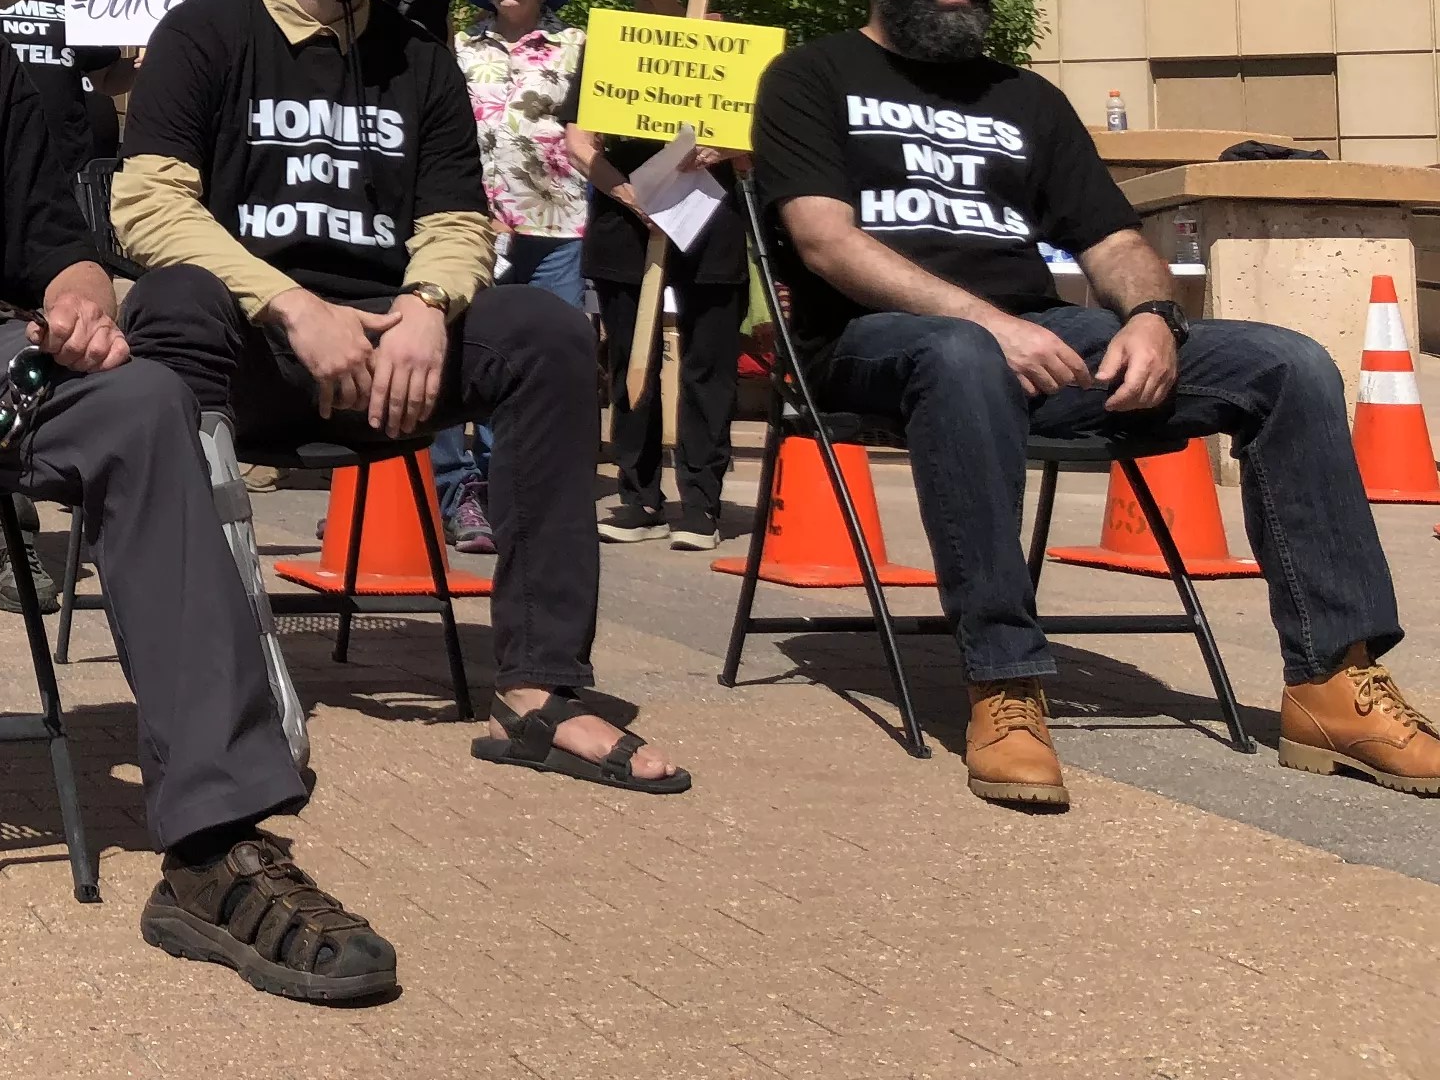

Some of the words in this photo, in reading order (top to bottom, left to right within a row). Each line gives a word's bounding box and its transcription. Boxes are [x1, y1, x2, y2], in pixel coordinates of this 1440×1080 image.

[2, 20, 51, 36] NOT
[619, 25, 698, 50] HOMES
[703, 34, 750, 55] NOT
[636, 56, 726, 81] HOTELS
[592, 80, 639, 105] Stop
[643, 86, 703, 109] Short
[846, 95, 1024, 151] HOUSES
[1110, 114, 1119, 125] G
[286, 153, 359, 189] NOT
[901, 143, 986, 185] NOT
[237, 202, 397, 249] HOTELS
[860, 188, 1030, 235] HOTELS
